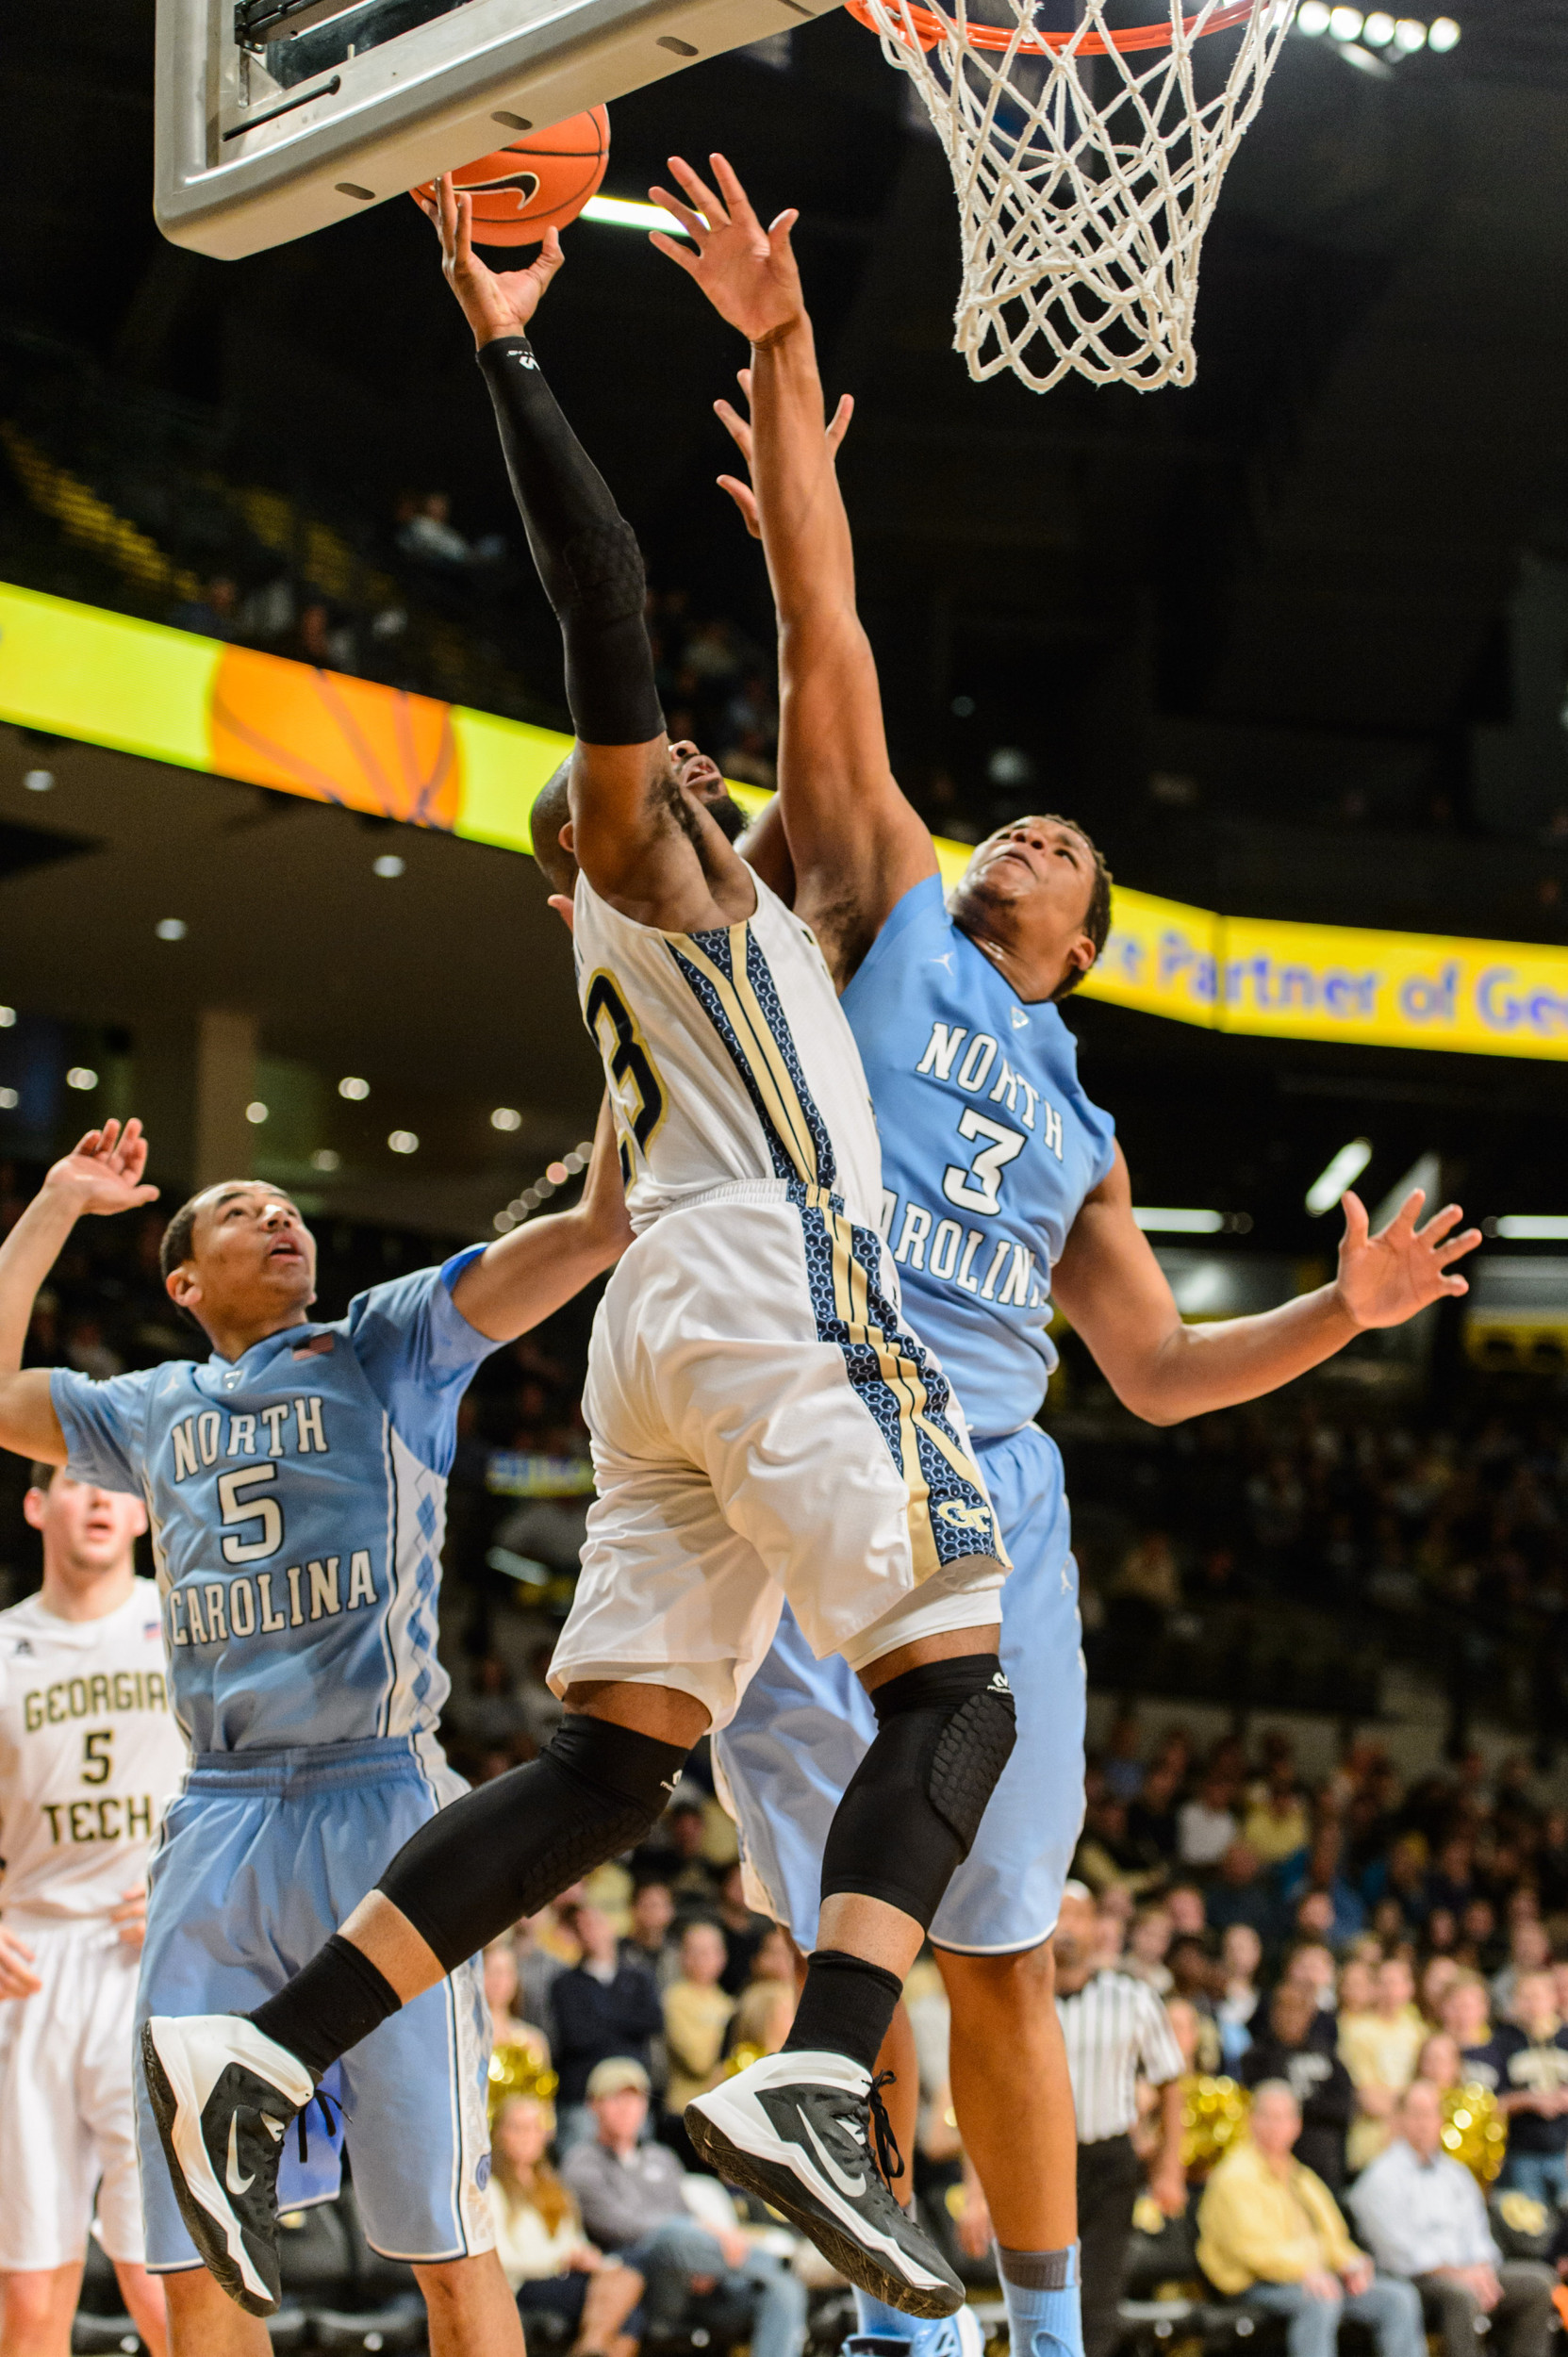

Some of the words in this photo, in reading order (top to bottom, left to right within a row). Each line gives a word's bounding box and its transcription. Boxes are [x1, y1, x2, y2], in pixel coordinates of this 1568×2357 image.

[1155, 928, 1378, 1019] Partner
[1398, 957, 1460, 1023] of
[1474, 962, 1568, 1038] Ge
[916, 1021, 1063, 1162] NORTH
[943, 1105, 1028, 1216] 3
[170, 1396, 328, 1484] NORTH
[217, 1460, 286, 1565] 5
[937, 1498, 991, 1533] GT
[169, 1549, 378, 1647] CAROLINA
[24, 1671, 169, 1734] GEORGIA
[80, 1727, 115, 1786] 5
[41, 1794, 153, 1846] TECH
